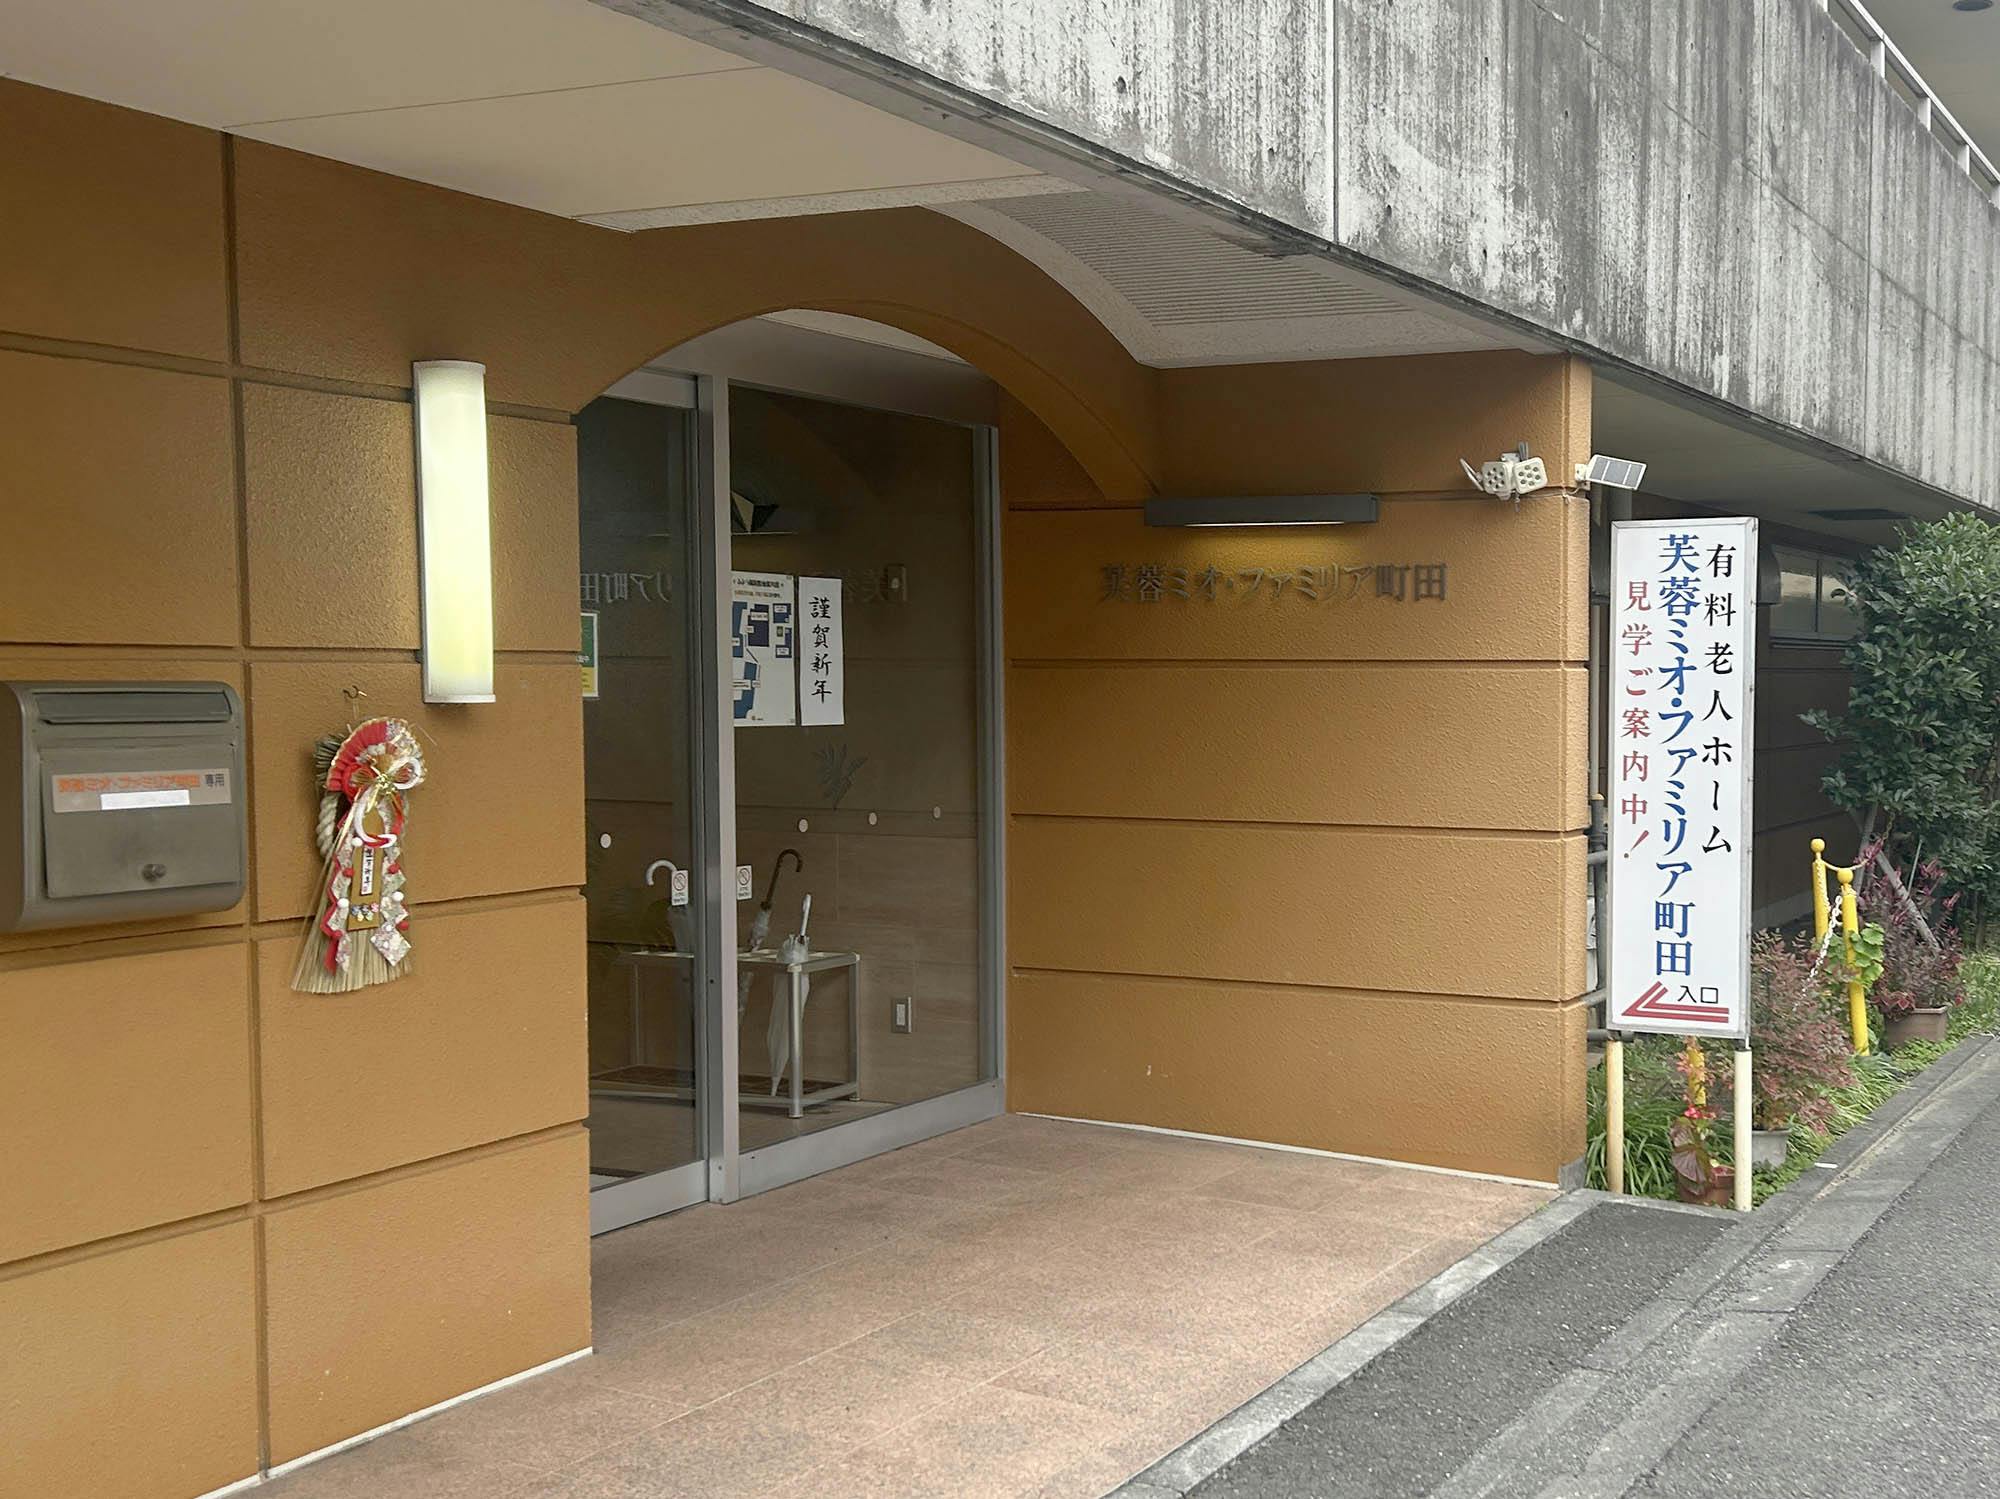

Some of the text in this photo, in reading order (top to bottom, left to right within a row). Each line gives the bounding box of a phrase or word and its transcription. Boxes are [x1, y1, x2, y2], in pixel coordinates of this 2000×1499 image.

[809, 597, 833, 704] 謹賀新年
[1621, 580, 1653, 859] 見学ご案内中！
[1656, 534, 1701, 976] 芙蓉ミオ・ファミリア町田
[1702, 543, 1737, 854] 有料老人ホーム
[1677, 985, 1719, 1004] 入口
